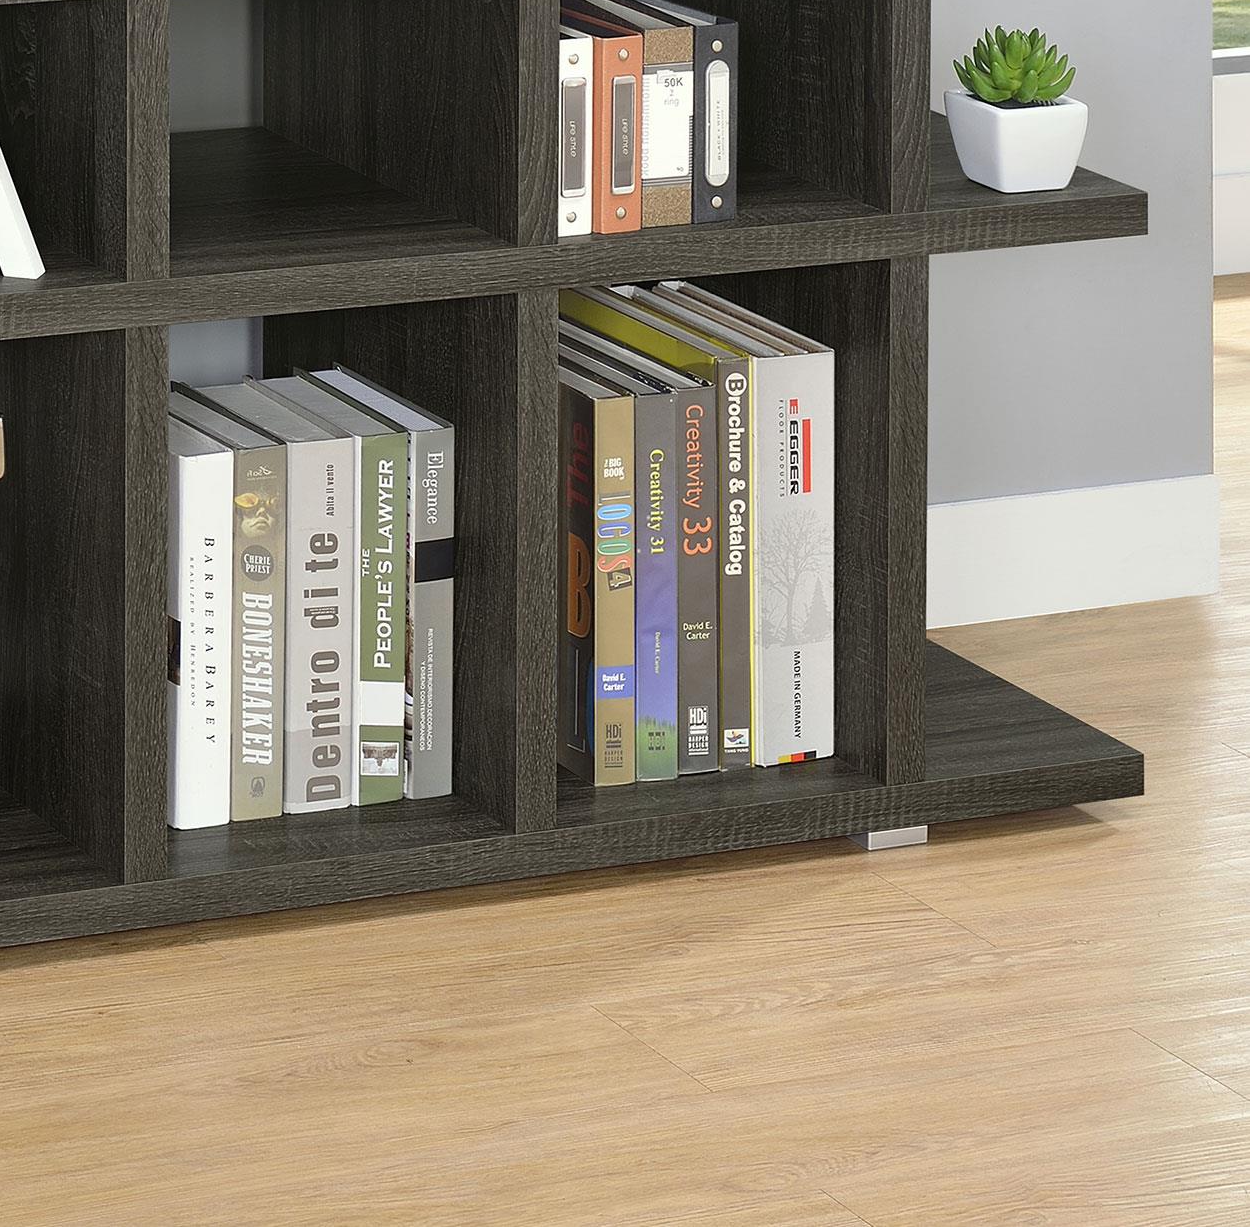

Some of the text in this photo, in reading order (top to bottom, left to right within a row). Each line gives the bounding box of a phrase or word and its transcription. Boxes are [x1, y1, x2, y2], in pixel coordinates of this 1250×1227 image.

[664, 77, 683, 88] 50K
[789, 420, 800, 496] EGGER
[604, 467, 625, 479] BOOK
[682, 404, 713, 556] Creativity 33
[724, 373, 748, 576] Brochure & Catalog
[421, 451, 444, 525] Elegance
[646, 449, 665, 555] Creativity 31
[375, 459, 394, 554] LAWYER
[243, 553, 271, 566] CHERIE
[245, 563, 271, 575] PRIEST
[361, 548, 370, 577] THE
[204, 537, 217, 744] BARBERA BAREY
[683, 621, 713, 631] David E.
[686, 631, 711, 641] Carter
[241, 591, 273, 766] BONESHAKER
[602, 673, 619, 682] David
[603, 682, 625, 692] Carter
[793, 650, 802, 739] MADE IN GERMANY
[306, 650, 342, 802] Dentro
[689, 707, 707, 724] HDi
[605, 724, 622, 739] HDi
